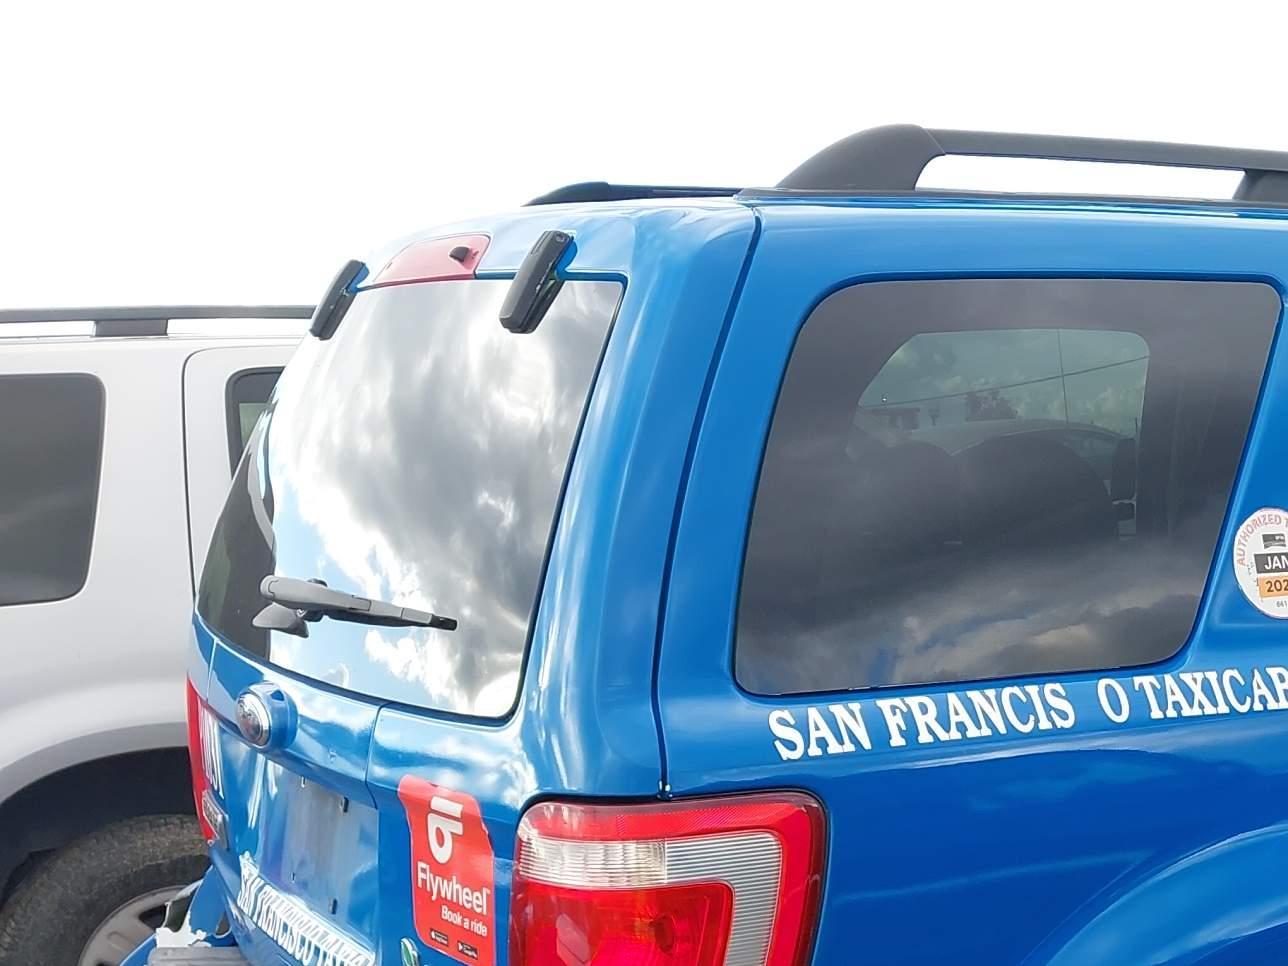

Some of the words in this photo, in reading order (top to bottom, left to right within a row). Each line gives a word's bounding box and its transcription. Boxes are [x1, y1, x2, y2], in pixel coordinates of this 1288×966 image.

[1236, 513, 1282, 567] AUTHORIZED
[768, 702, 871, 761] SAN
[876, 683, 1076, 747] FRANCIS
[1096, 677, 1131, 724] O
[417, 861, 490, 915] Flywheel
[253, 884, 316, 966] FRANCISCO
[441, 905, 462, 926] Book
[463, 918, 469, 930] a
[470, 919, 488, 937] ride
